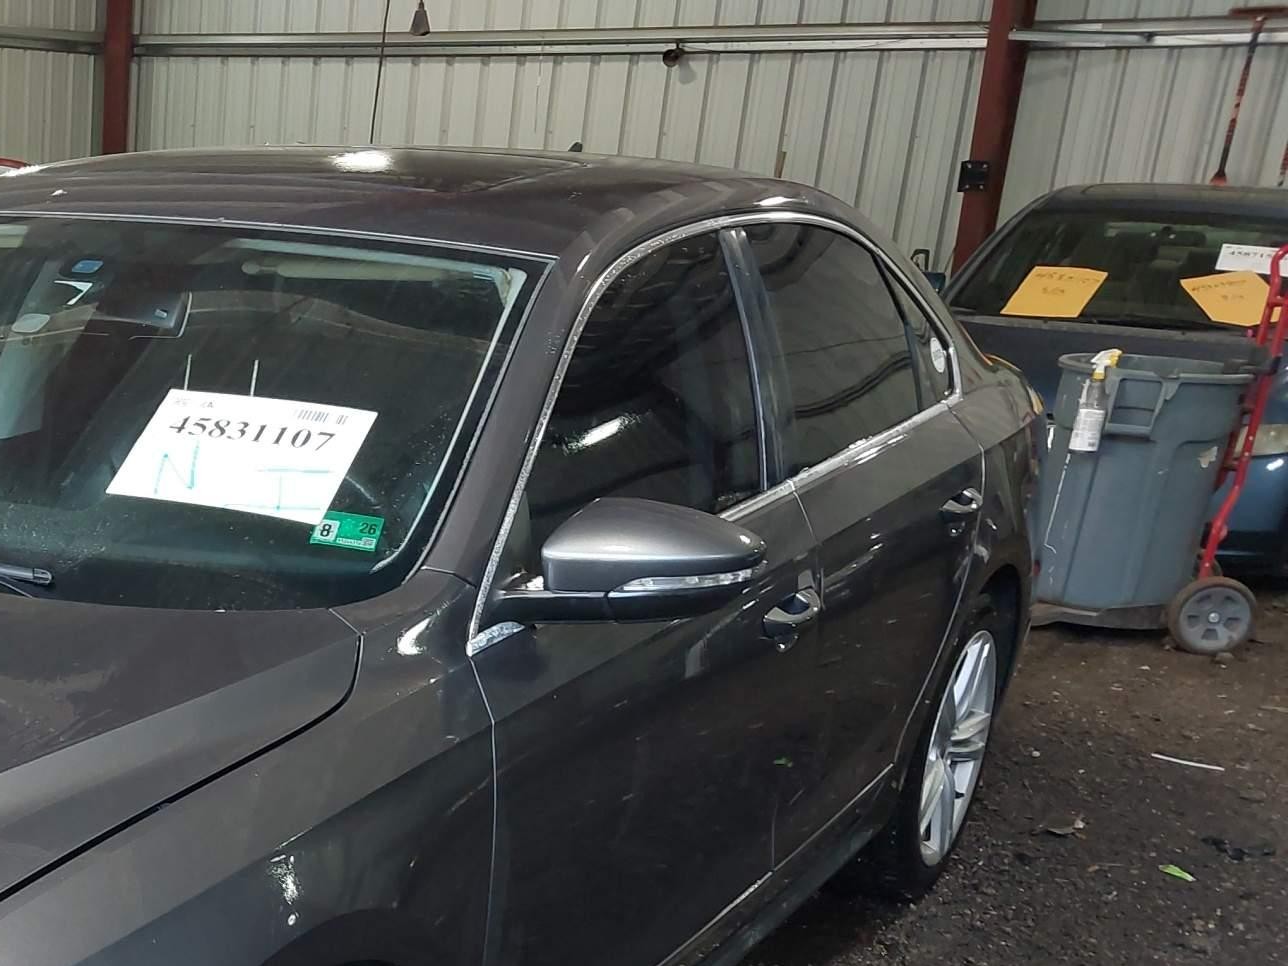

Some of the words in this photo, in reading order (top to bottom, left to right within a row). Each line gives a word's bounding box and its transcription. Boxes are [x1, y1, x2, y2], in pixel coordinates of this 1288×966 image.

[168, 415, 336, 451] 45831107
[319, 523, 332, 537] 8
[359, 522, 379, 536] 26
